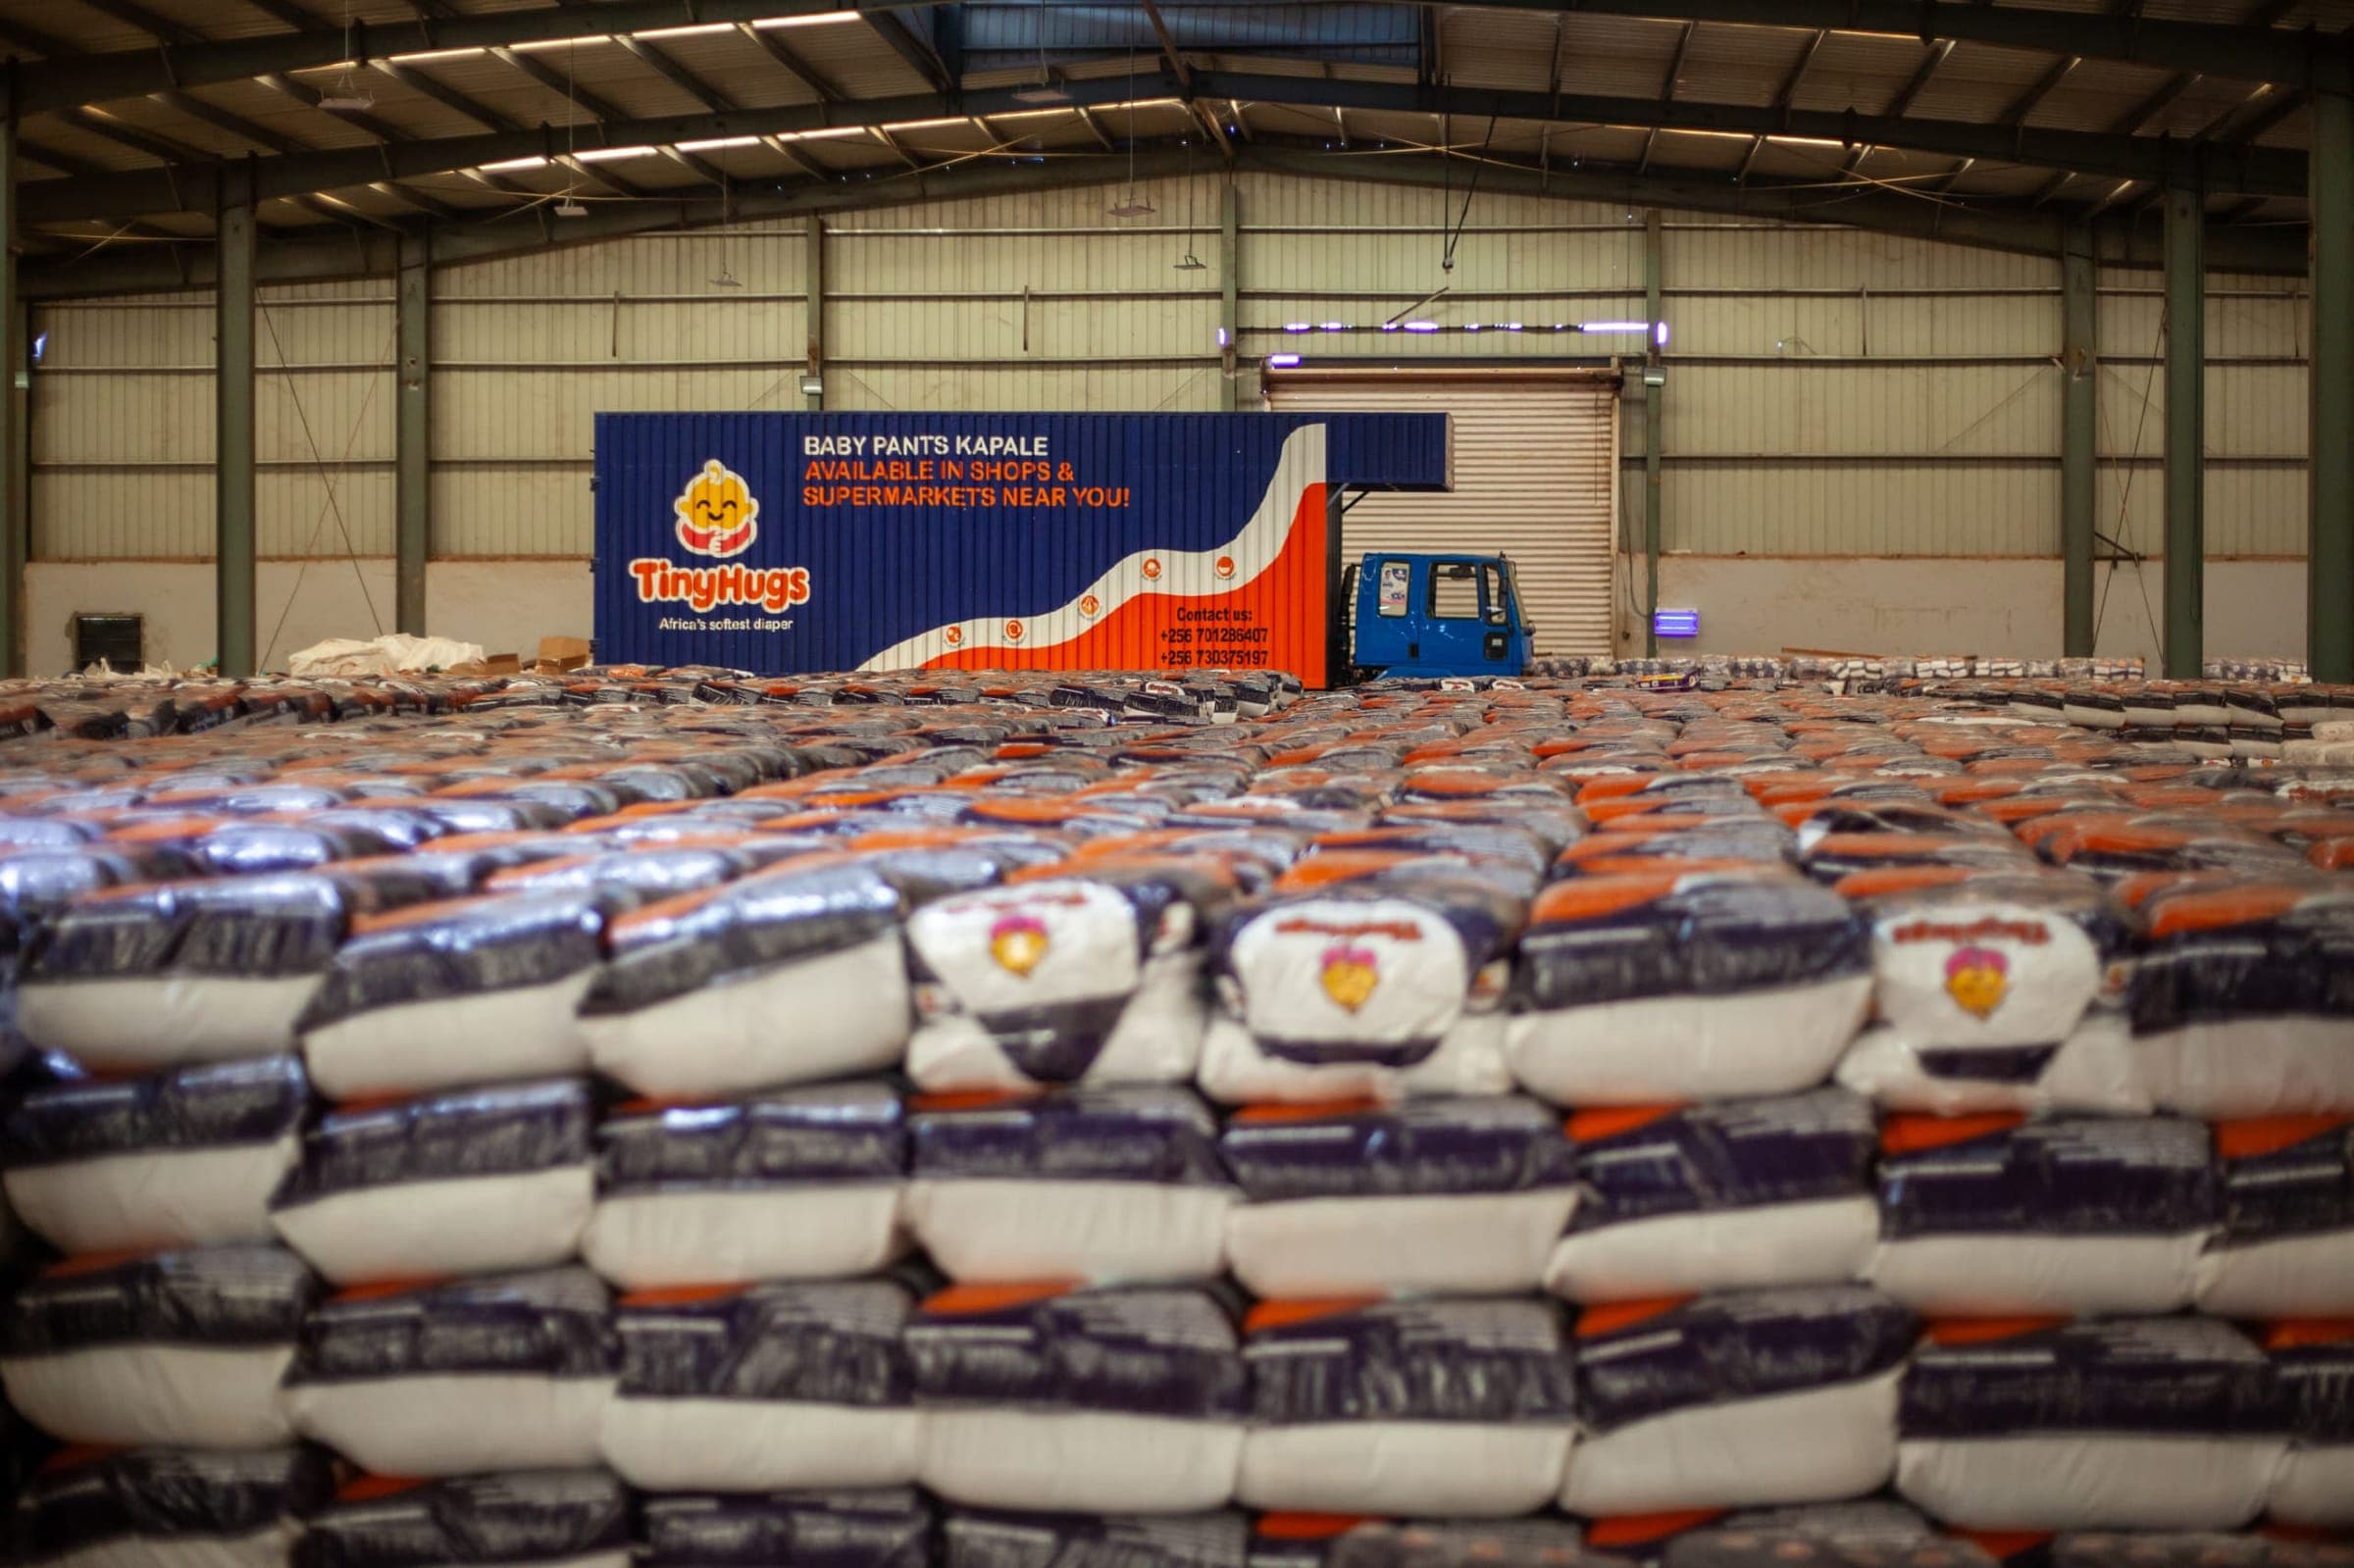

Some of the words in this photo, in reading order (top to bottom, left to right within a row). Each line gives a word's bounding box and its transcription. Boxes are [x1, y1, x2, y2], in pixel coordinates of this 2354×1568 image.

[804, 436, 866, 456] BABY
[873, 436, 948, 456] PANTS
[956, 436, 1049, 456] KAPALE
[805, 461, 934, 481] AVAILABLE
[941, 461, 963, 481] IN
[970, 461, 1050, 481] SHOPS
[1057, 462, 1074, 481] &
[803, 486, 996, 507] SUPERMARKETS
[1002, 487, 1066, 507] NEAR
[1072, 487, 1130, 507] YOU!
[631, 560, 809, 612] TinyHugs
[1177, 607, 1229, 622] Contact
[1233, 610, 1253, 622] us:
[659, 618, 706, 631] Africa's
[709, 618, 750, 631] softest
[753, 618, 793, 632] diaper
[1161, 629, 1192, 643] +256
[1197, 628, 1268, 643] 701286407
[1161, 650, 1192, 665] +256
[1197, 650, 1268, 665] 730375197
